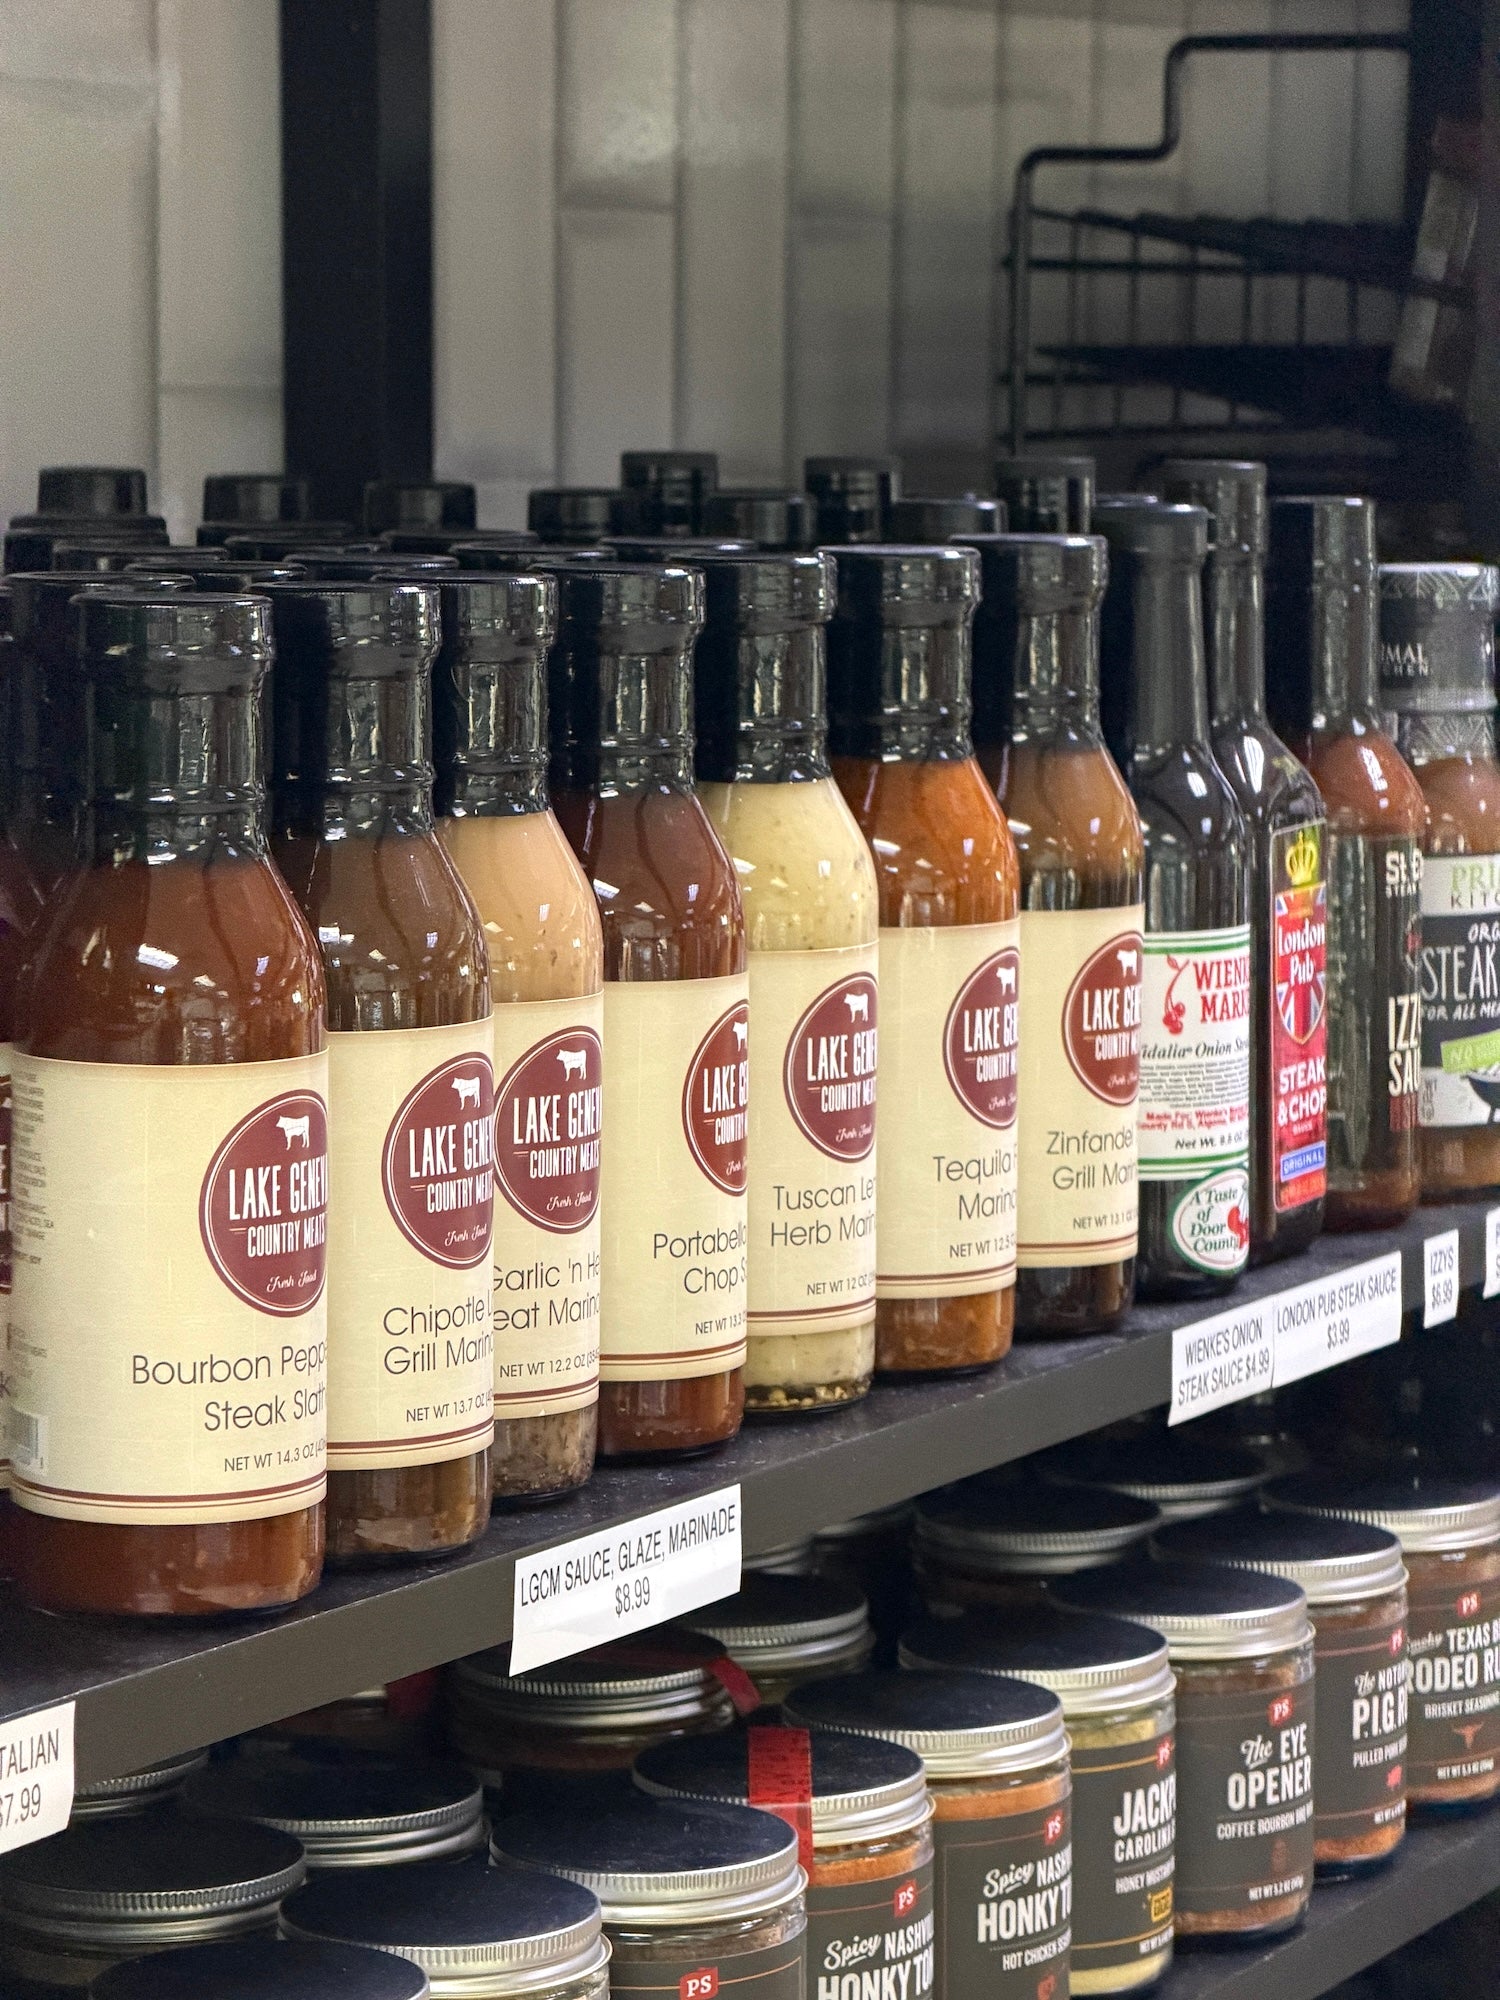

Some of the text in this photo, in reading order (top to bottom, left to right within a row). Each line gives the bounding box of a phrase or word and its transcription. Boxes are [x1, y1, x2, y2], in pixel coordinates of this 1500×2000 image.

[1452, 863, 1500, 892] PRI
[1279, 918, 1325, 957] London
[1468, 920, 1500, 944] ORG
[1290, 951, 1314, 987] Pub
[1420, 944, 1499, 1001] STEAK
[1083, 987, 1120, 1031] LAKE
[1388, 992, 1422, 1051] IZZ
[1453, 1002, 1476, 1020] ALL
[964, 1006, 1000, 1053] LAKE
[1095, 1031, 1129, 1061] COUNTRY
[807, 1028, 877, 1082] LAKE GENE
[1196, 1040, 1232, 1058] Onion
[976, 1052, 1009, 1083] COUNTRY
[1280, 1055, 1326, 1094] STEAK
[1388, 1049, 1421, 1097] SAU
[703, 1060, 747, 1113] LAKE GE
[821, 1082, 861, 1113] COUNTRY
[513, 1085, 602, 1144] LAKE GENEV
[715, 1113, 744, 1145] COUNTRY
[409, 1125, 457, 1178] LAKE
[1175, 1138, 1196, 1149] Net
[530, 1145, 577, 1179] COUNTRY
[933, 1148, 1011, 1185] Tequila
[1053, 1158, 1137, 1190] Grill Mari
[1284, 1150, 1323, 1176] ORIGINAL
[229, 1152, 328, 1221] LAKE GENEV
[426, 1179, 473, 1214] COUNTRY
[773, 1176, 876, 1210] Tuscan Le
[1189, 1188, 1238, 1206] A Taste
[1073, 1215, 1092, 1230] NET
[1094, 1214, 1108, 1227] WT
[1190, 1223, 1227, 1237] Door
[1197, 1206, 1214, 1223] of
[247, 1221, 300, 1258] COUNTRY
[771, 1220, 831, 1247] Herb
[949, 1243, 972, 1259] NET
[975, 1240, 991, 1256] WT
[588, 1251, 599, 1280] He
[684, 1256, 747, 1293] Chop S
[1430, 1244, 1454, 1278] IZZYS
[807, 1281, 826, 1296] NET
[830, 1279, 844, 1293] WT
[1277, 1267, 1397, 1334] LONDON PUB STEAK SAUCE
[383, 1296, 484, 1338] Chipotle
[494, 1301, 540, 1331] eat
[695, 1317, 727, 1335] NET WT
[1185, 1316, 1262, 1368] WIENKE'S ONION
[1327, 1318, 1350, 1350] $3.99
[133, 1340, 327, 1385] Bourbon Pepp
[384, 1342, 436, 1375] Grill
[500, 1363, 523, 1378] NET
[527, 1361, 545, 1376] WT
[550, 1357, 571, 1374] 12.2
[574, 1353, 586, 1369] OZ
[1178, 1347, 1270, 1407] STEAK SAUCE $4.99
[204, 1395, 286, 1431] Steak
[406, 1406, 430, 1422] NET
[433, 1403, 449, 1419] WT
[454, 1397, 473, 1415] 13.7
[475, 1392, 485, 1409] OZ
[225, 1443, 315, 1472] NET WT 14.3 OZ
[521, 1504, 736, 1607] LGCM SAUCE, GLAZE, MARINADE
[615, 1576, 650, 1618] $8.99
[1446, 1622, 1491, 1654] TEXAS
[1405, 1653, 1479, 1695] RODEO
[1274, 1698, 1290, 1721] PS
[1424, 1700, 1463, 1719] BRISKET
[0, 1728, 59, 1781] TALIAN
[1240, 1722, 1307, 1770] The EYE
[1353, 1746, 1384, 1769] PULLED
[1227, 1755, 1312, 1811] OPENER
[1216, 1820, 1256, 1840] COFFEE
[1258, 1809, 1296, 1836] BOURBON
[983, 1861, 1035, 1898] Spicy
[898, 1885, 914, 1910] PS
[977, 1885, 1060, 1943] HONKY
[824, 1934, 881, 1970] Spicy
[1002, 1952, 1023, 1971] HOT
[686, 1974, 712, 1997] PS
[818, 1959, 912, 2000] HONKY
